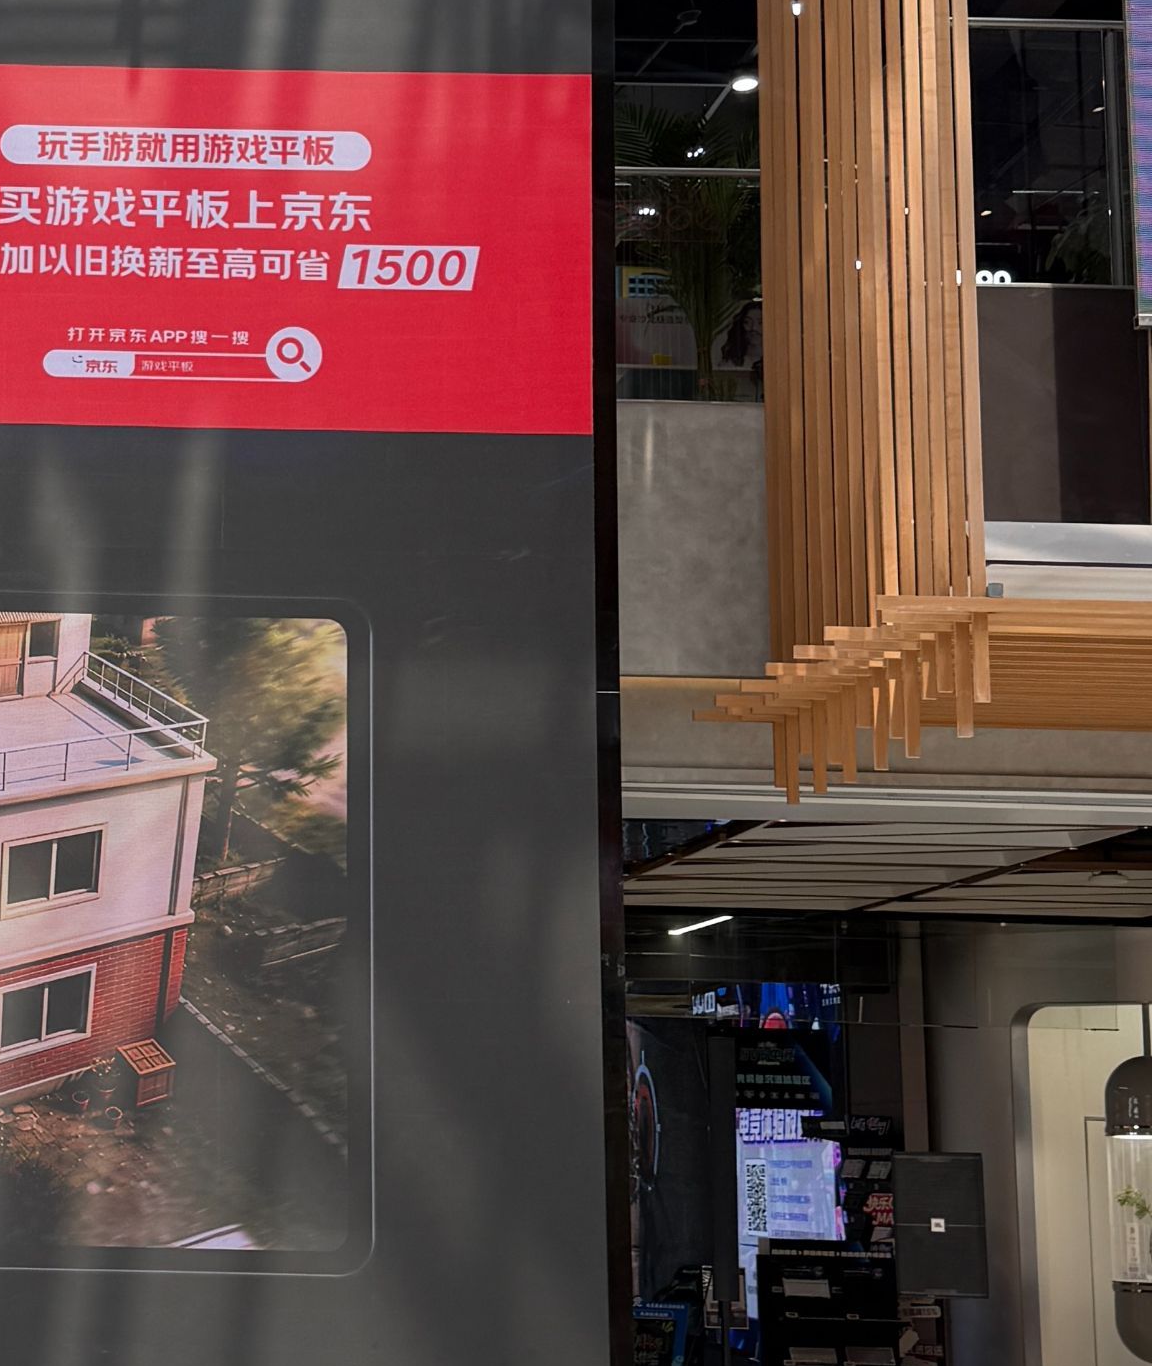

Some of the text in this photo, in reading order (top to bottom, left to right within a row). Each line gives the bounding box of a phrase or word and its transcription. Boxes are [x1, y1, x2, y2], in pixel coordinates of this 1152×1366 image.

[36, 130, 336, 167] 玩手游就用游戏平板
[350, 248, 470, 288] 1500
[67, 326, 251, 347] 打开京东APP搜一搜
[85, 358, 119, 374] 京东
[141, 359, 194, 373] 游戏平板
